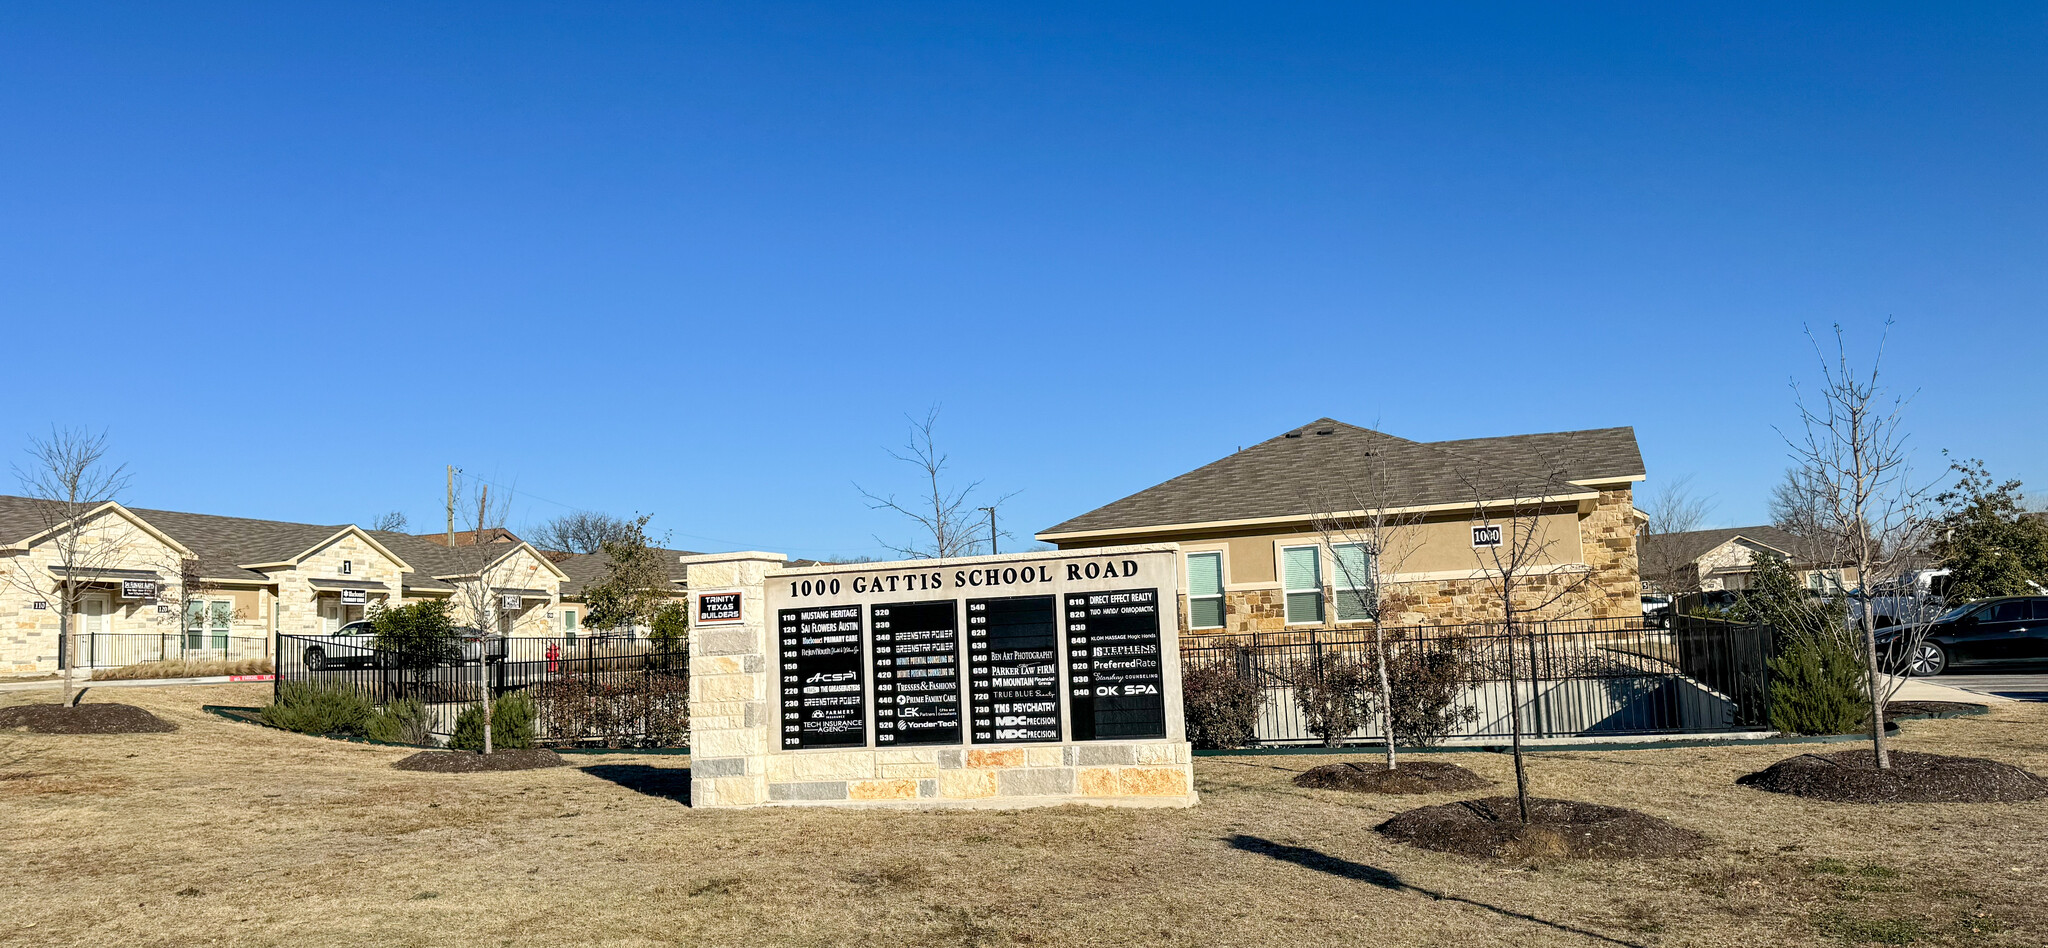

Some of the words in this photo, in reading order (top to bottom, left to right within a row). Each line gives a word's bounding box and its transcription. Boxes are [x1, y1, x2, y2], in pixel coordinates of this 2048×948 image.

[345, 562, 350, 572] 1
[790, 578, 840, 597] 1000
[853, 572, 942, 593] GATTIS
[955, 566, 1053, 587] SCHOOL
[1066, 560, 1138, 580] ROAD
[705, 595, 735, 603] TRINITY
[1090, 595, 1109, 605] DIRECT
[1111, 594, 1130, 603] EFFECT
[1131, 593, 1152, 602] REALTY
[707, 603, 734, 611] TEXAS
[701, 611, 739, 619] BUILDERS
[801, 611, 829, 620] MUSTANG
[830, 609, 857, 618] HERITAGE
[895, 631, 930, 641] GREENSTAR
[931, 630, 953, 638] POWER
[896, 644, 930, 653] GREENSTAR
[932, 642, 953, 651] POWER
[992, 666, 1019, 676] PARKER
[1021, 666, 1035, 675] LAW
[1037, 664, 1055, 674] FIRM
[1003, 677, 1034, 687] MOUNTAIN
[1096, 686, 1119, 696] OK
[1124, 684, 1158, 695] SPA
[804, 697, 838, 706] GREENSTAR
[839, 696, 860, 705] POWER
[898, 707, 920, 717] LEK
[1013, 702, 1055, 712] PSYCHIATRY
[907, 720, 957, 728] YonderTech
[995, 716, 1026, 726] MDC
[1027, 717, 1056, 725] PRECISION
[996, 729, 1027, 740] MDC
[1027, 730, 1056, 738] PRECISION
